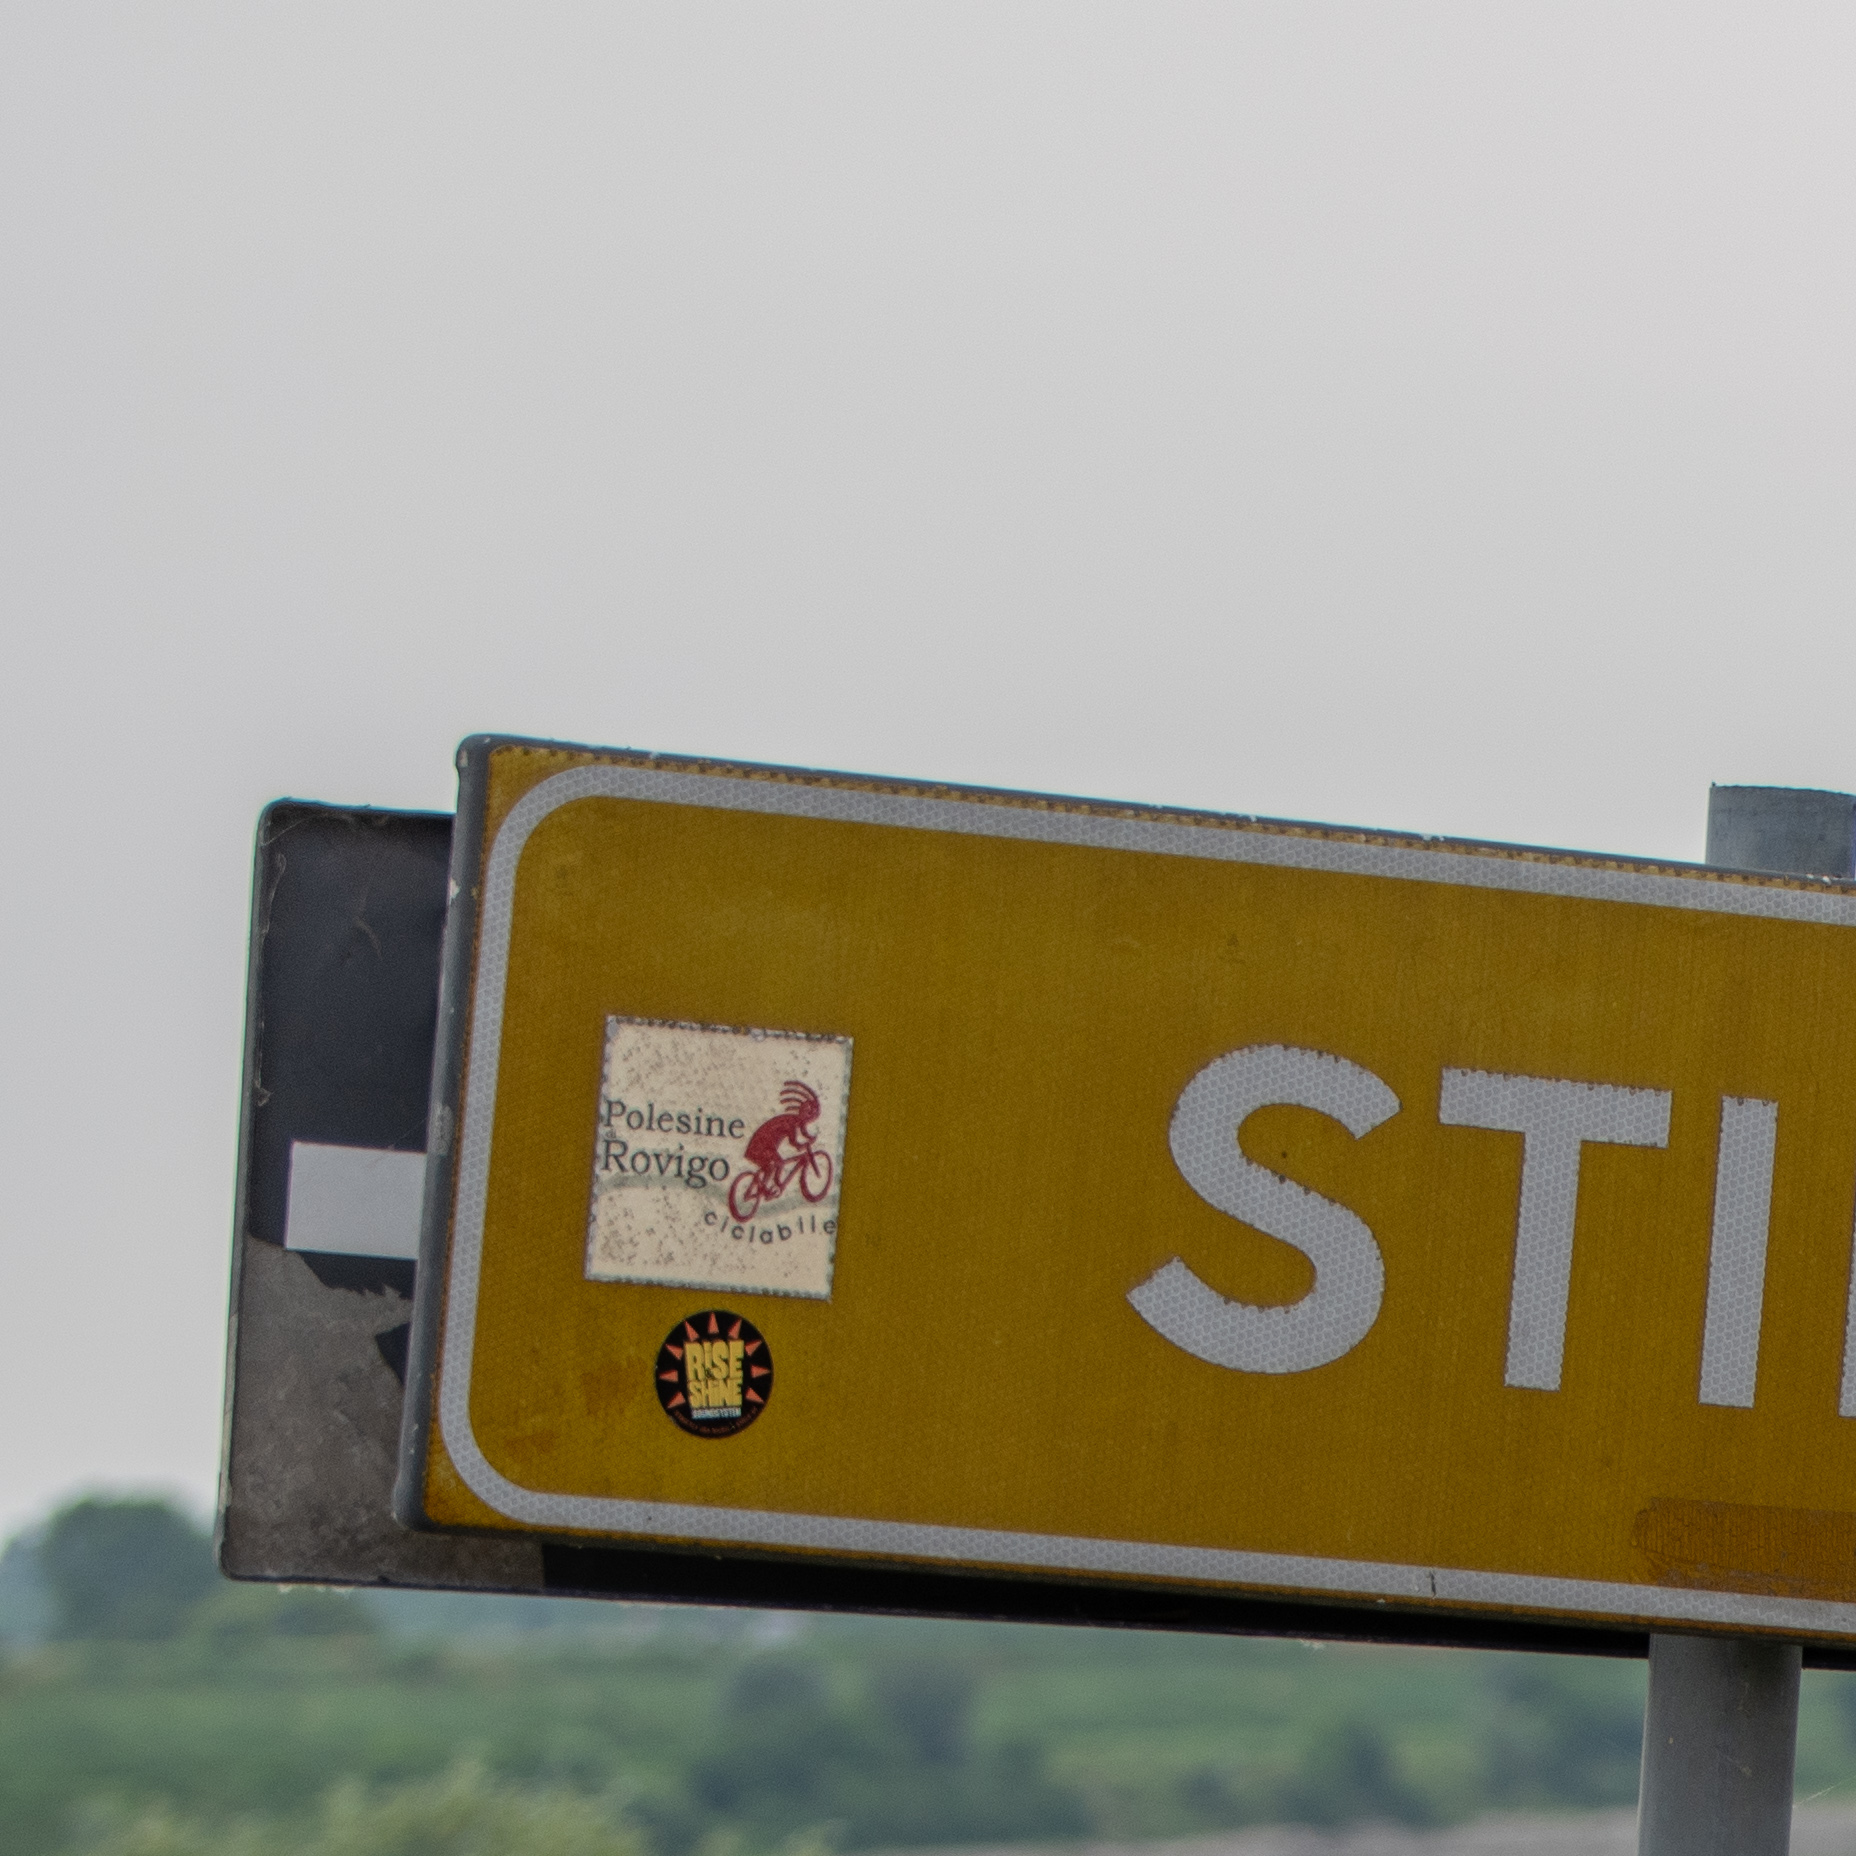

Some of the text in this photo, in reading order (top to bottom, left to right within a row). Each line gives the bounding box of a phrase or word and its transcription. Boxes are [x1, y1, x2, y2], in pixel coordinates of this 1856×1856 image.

[602, 1099, 746, 1139] Polesine
[600, 1139, 731, 1189] Rovigo
[704, 1210, 837, 1244] ciclabile
[684, 1338, 745, 1380] RISE
[688, 1379, 743, 1408] SHINE
